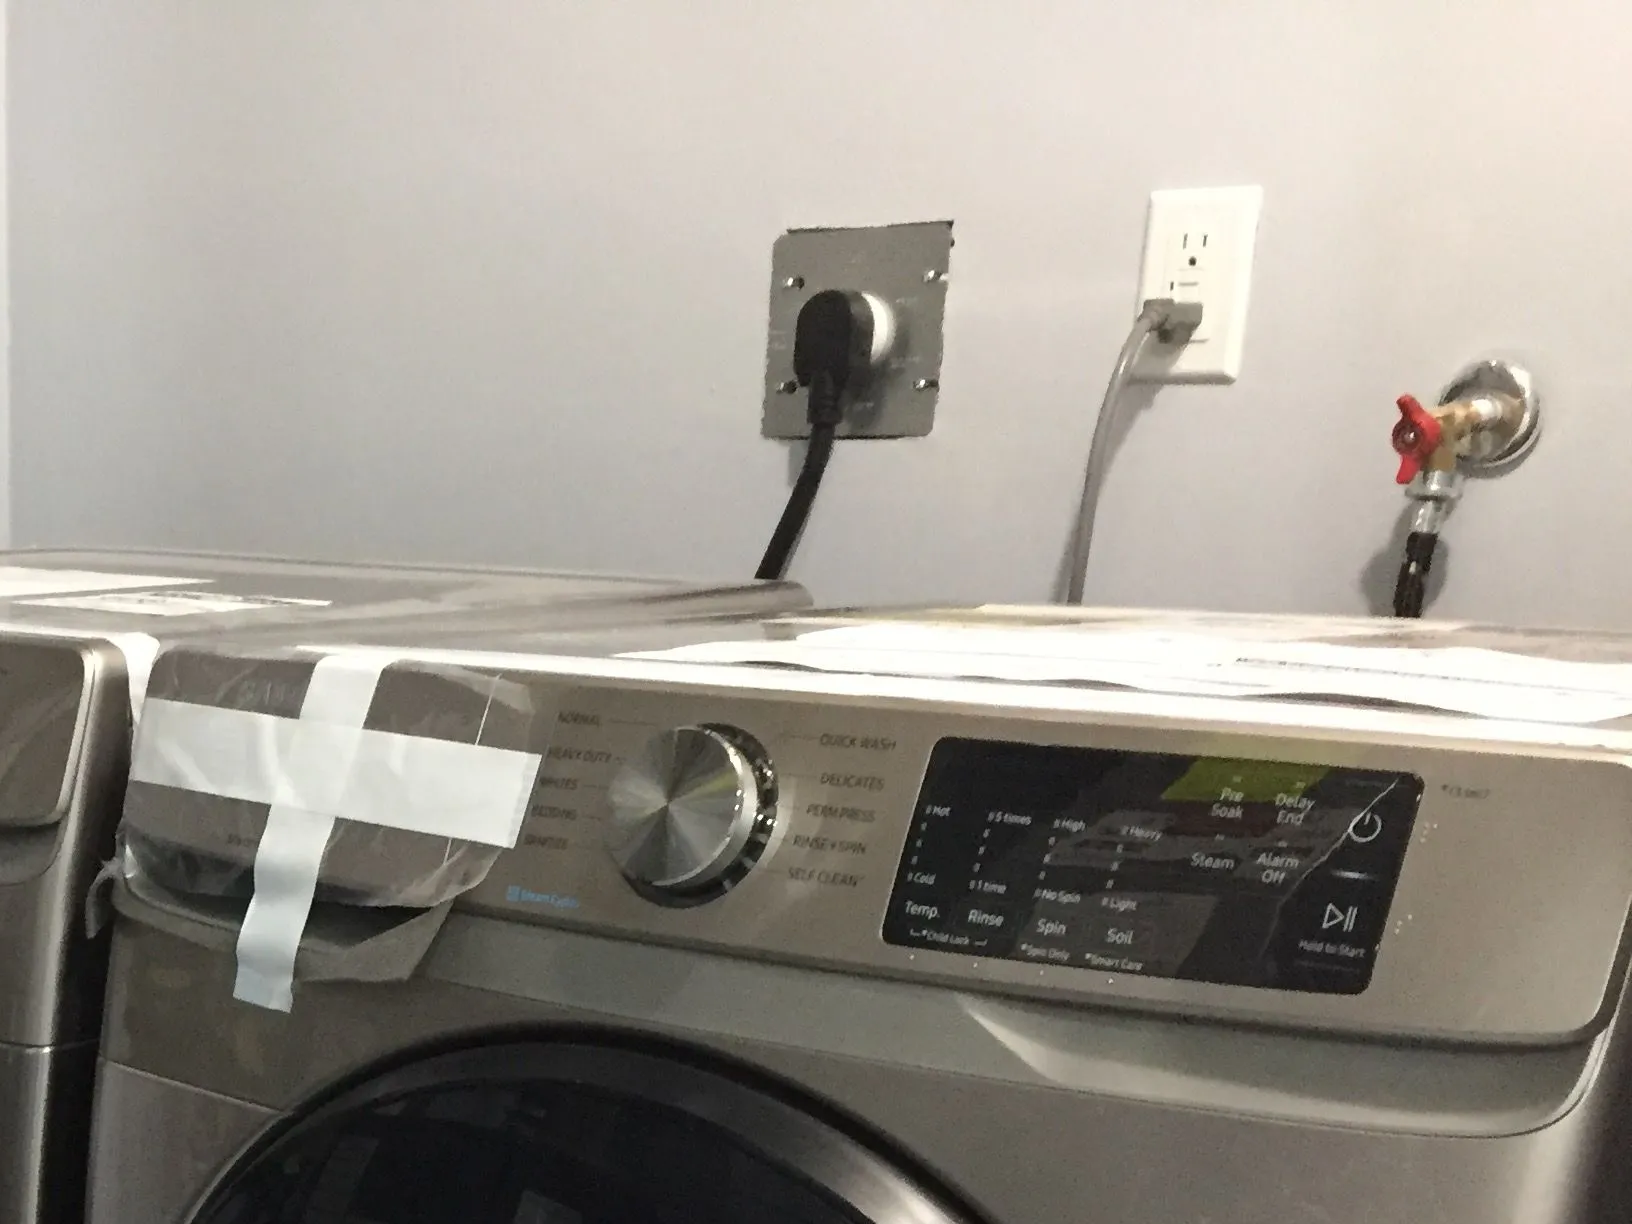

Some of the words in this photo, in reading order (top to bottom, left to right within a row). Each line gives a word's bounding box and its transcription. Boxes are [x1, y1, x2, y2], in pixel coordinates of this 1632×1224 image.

[820, 733, 857, 748] QUICK
[860, 737, 896, 750] WASH
[820, 772, 884, 792] DELICATES
[1220, 787, 1245, 803] Pre
[1275, 792, 1317, 811] Delay
[1003, 812, 1032, 827] times
[1211, 803, 1244, 821] Soak
[1276, 810, 1305, 826] End
[1060, 818, 1086, 833] High
[1191, 851, 1235, 870] Steam
[1256, 852, 1300, 869] Alarm
[913, 872, 936, 886] Cold
[1109, 898, 1138, 912] Light
[968, 909, 1005, 928] Rinse
[1036, 918, 1067, 936] Spin
[1106, 928, 1134, 945] Soil
